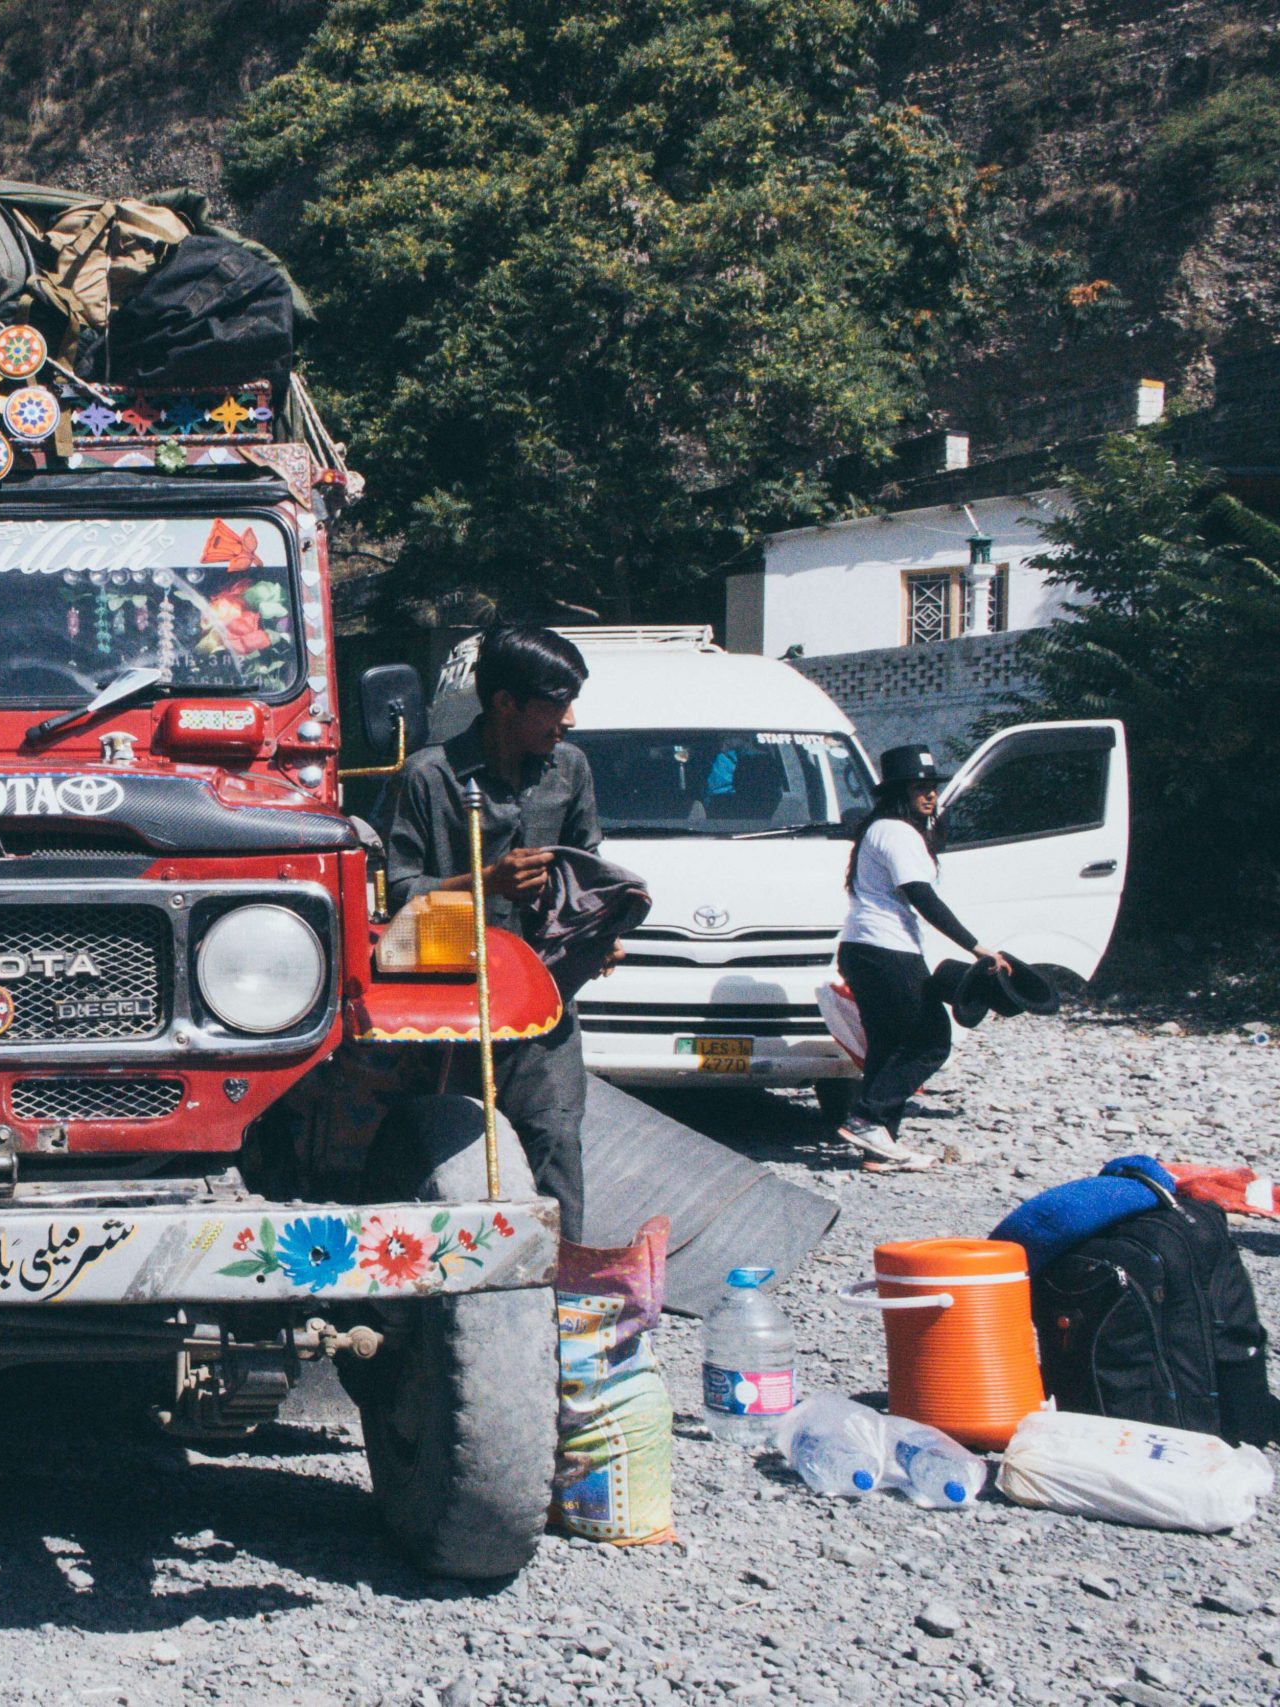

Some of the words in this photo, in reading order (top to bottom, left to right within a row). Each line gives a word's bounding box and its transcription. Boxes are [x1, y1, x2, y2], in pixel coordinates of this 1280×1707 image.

[756, 733, 792, 744] STAFF
[793, 734, 825, 745] DUTY
[58, 999, 150, 1019] DIESEL
